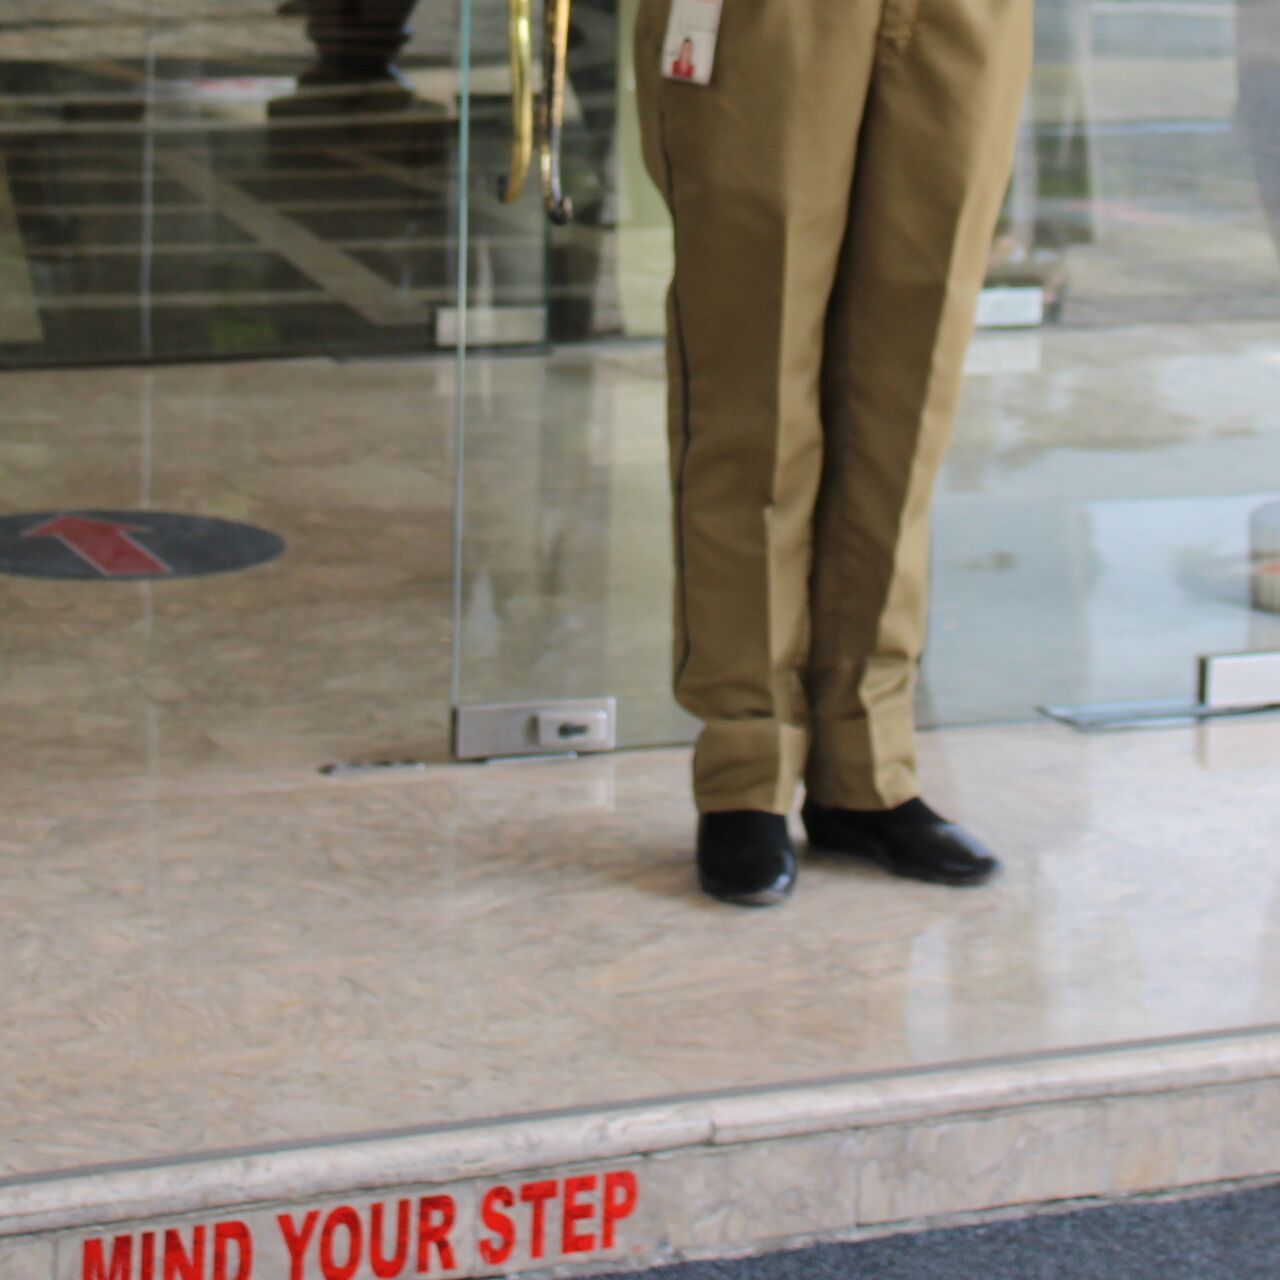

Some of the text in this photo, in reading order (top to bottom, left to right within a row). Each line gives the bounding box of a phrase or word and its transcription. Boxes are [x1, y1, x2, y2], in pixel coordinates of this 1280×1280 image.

[82, 1171, 638, 1280] MIND YOUR STEP
